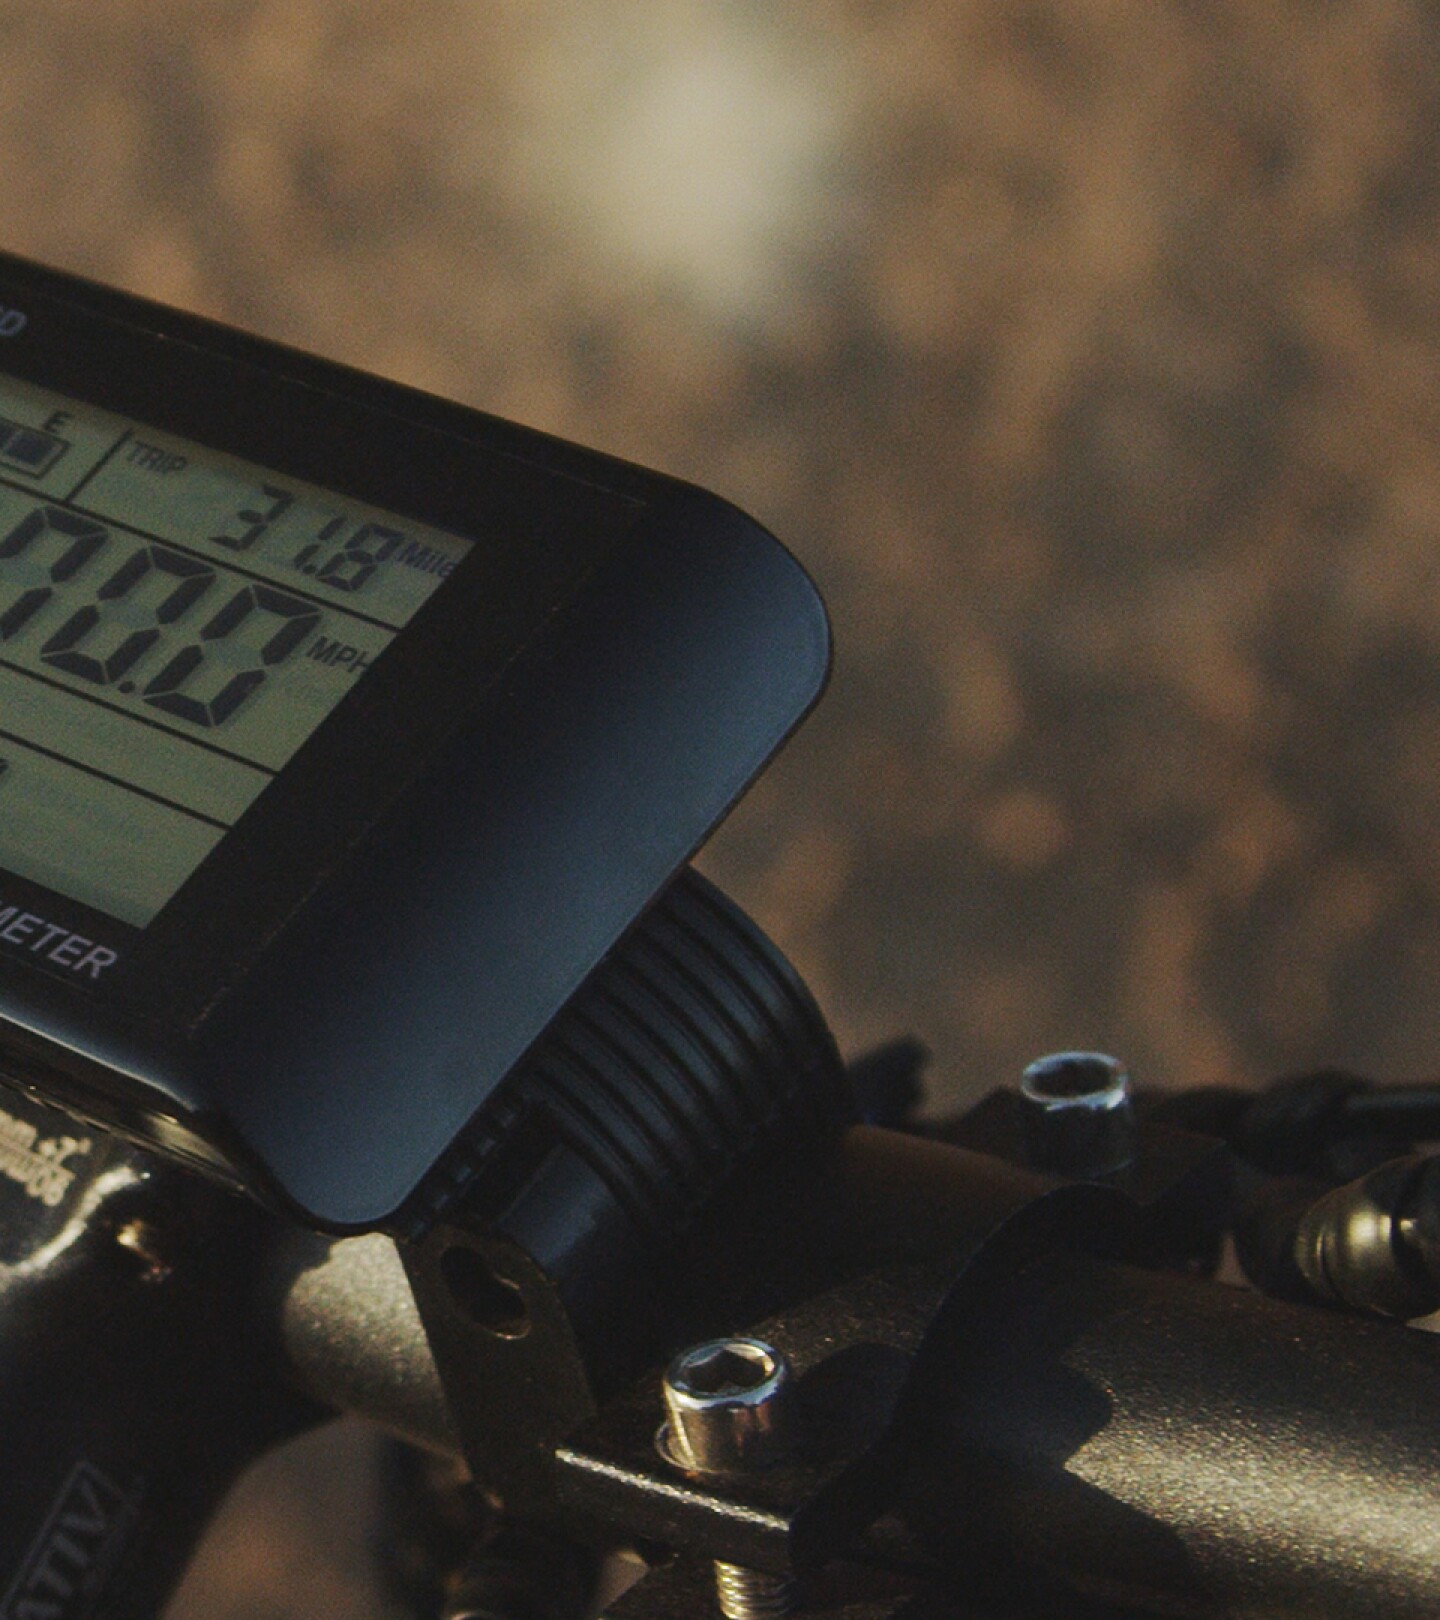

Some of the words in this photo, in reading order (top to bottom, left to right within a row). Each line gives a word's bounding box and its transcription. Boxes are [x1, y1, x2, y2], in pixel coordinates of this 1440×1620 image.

[41, 411, 75, 433] E
[126, 441, 189, 474] TRIP
[208, 484, 404, 592] 31.8
